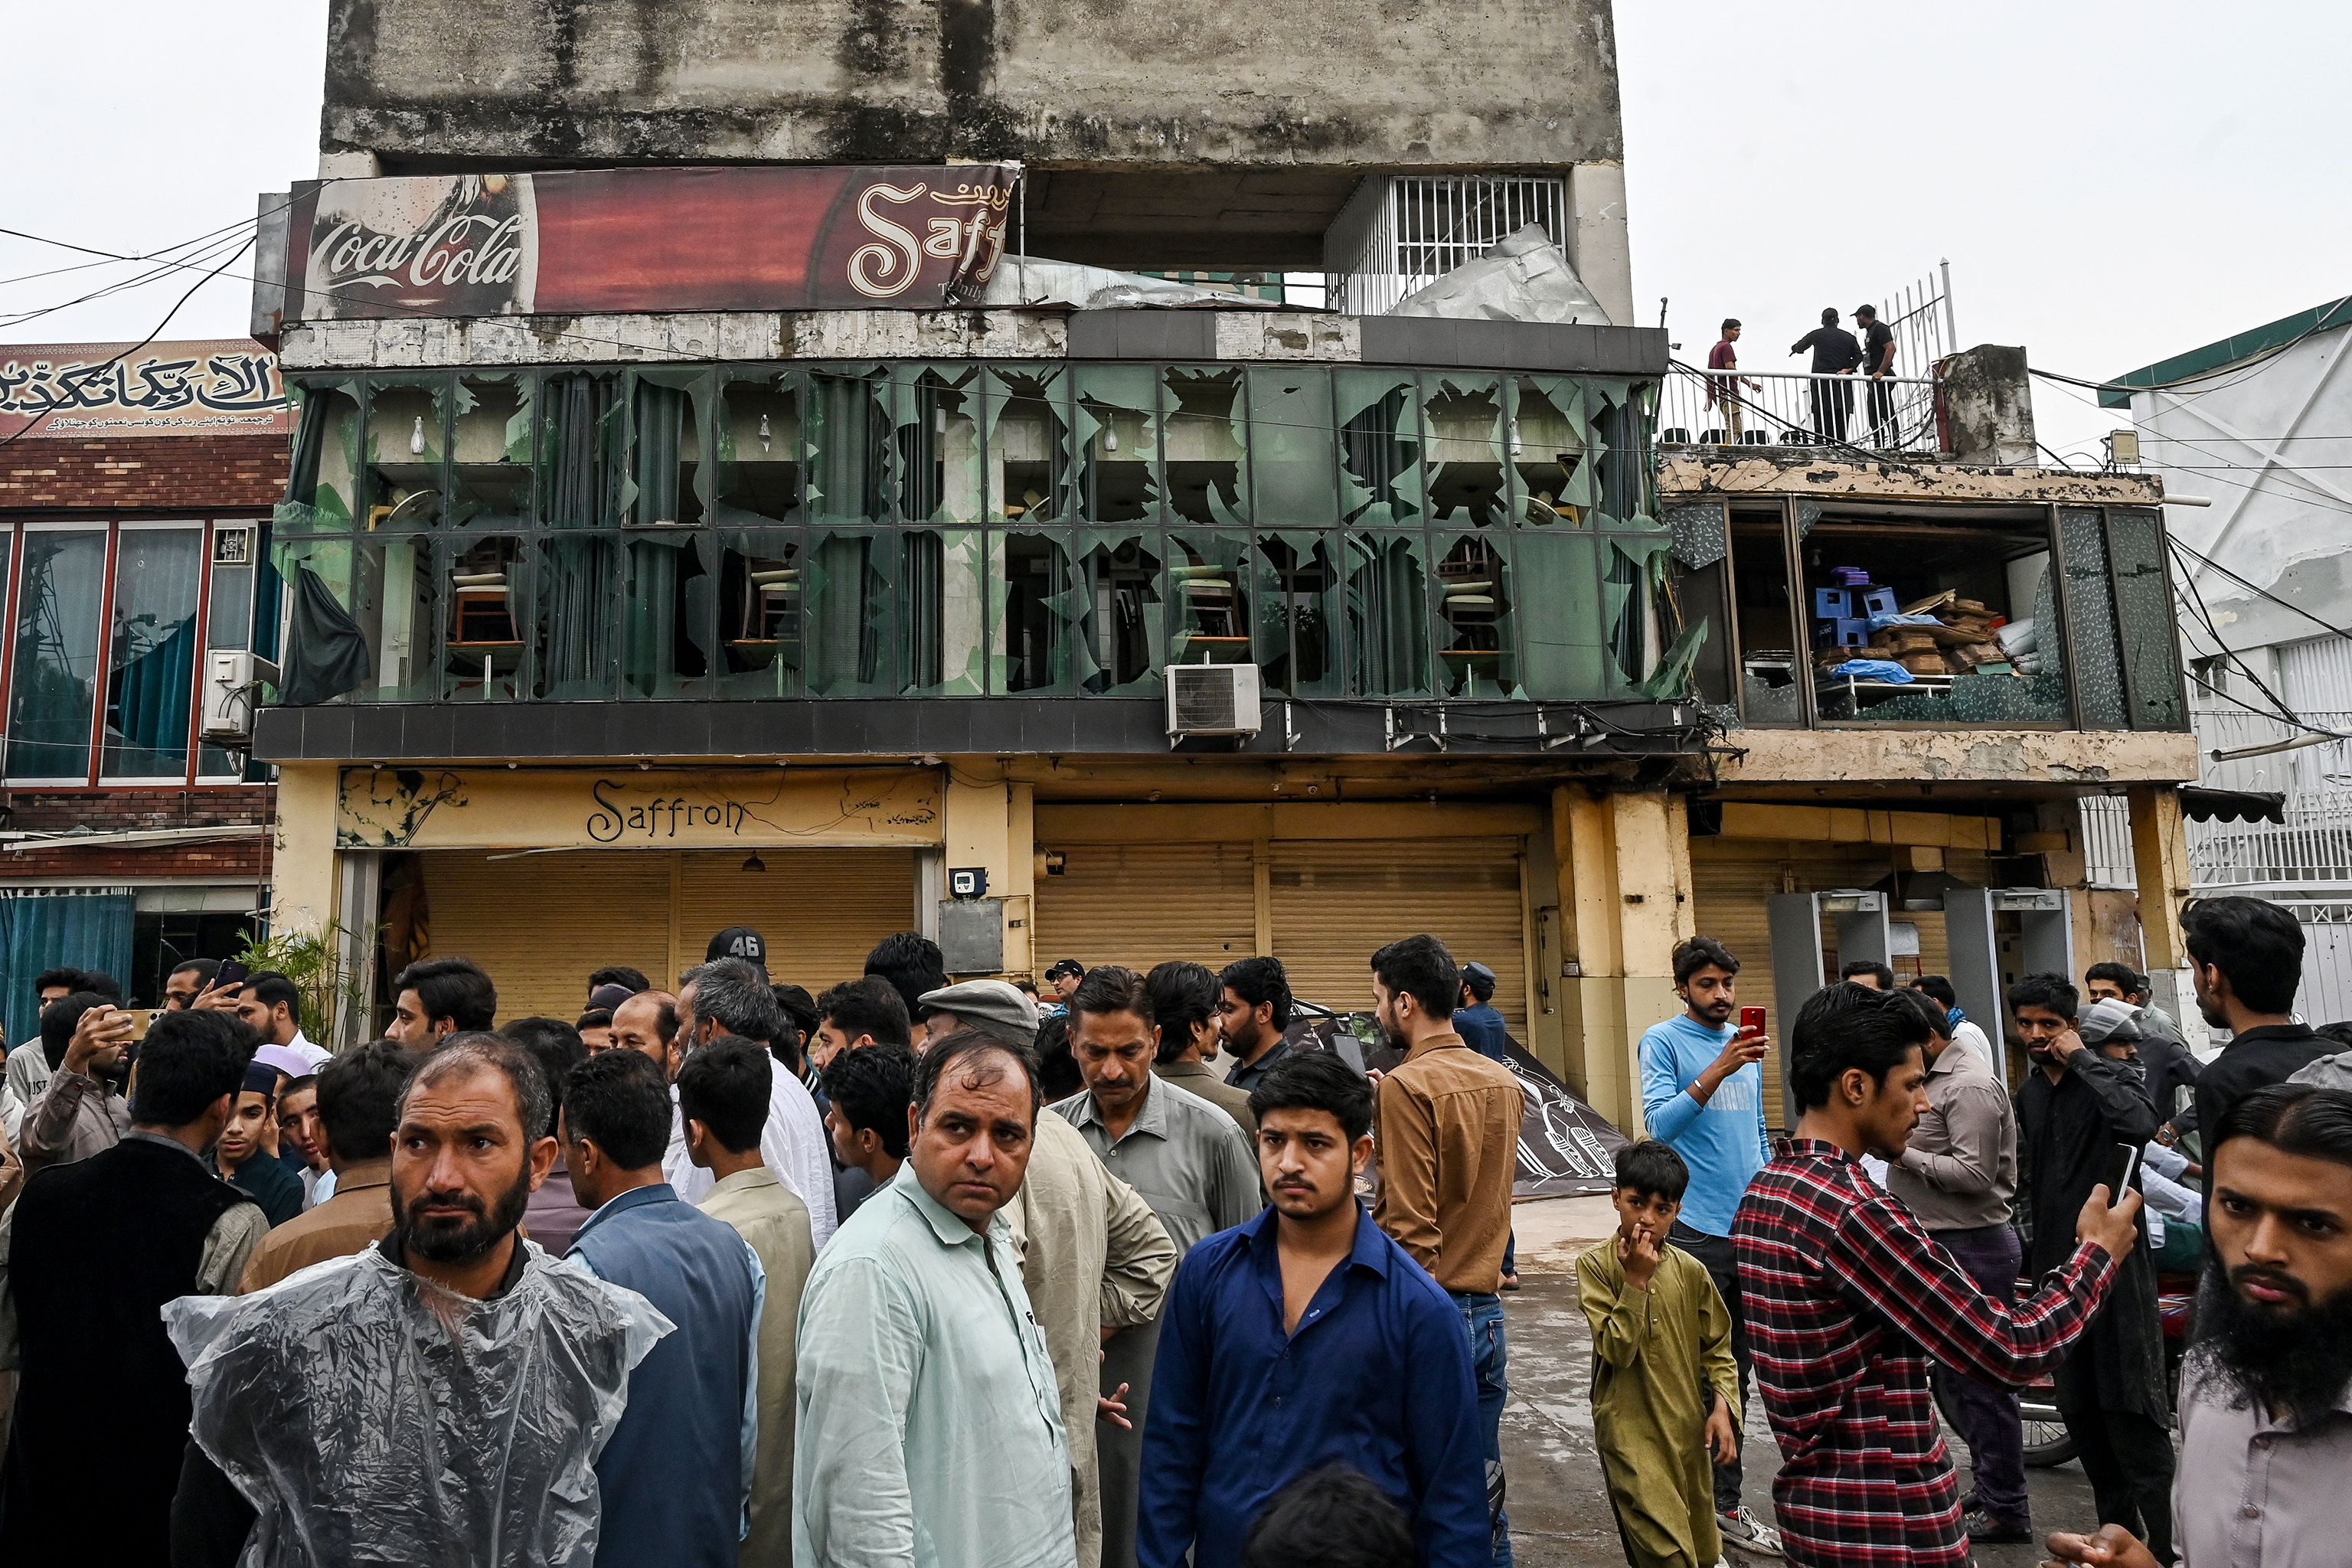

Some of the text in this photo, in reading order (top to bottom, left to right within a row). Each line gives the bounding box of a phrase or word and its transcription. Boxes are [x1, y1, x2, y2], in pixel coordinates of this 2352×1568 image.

[305, 214, 522, 289] Coca-Cola
[87, 419, 97, 428] کو
[155, 417, 171, 426] کون
[172, 417, 183, 426] کی
[185, 418, 197, 426] رب
[587, 779, 744, 842] Saffron
[729, 936, 760, 957] 46
